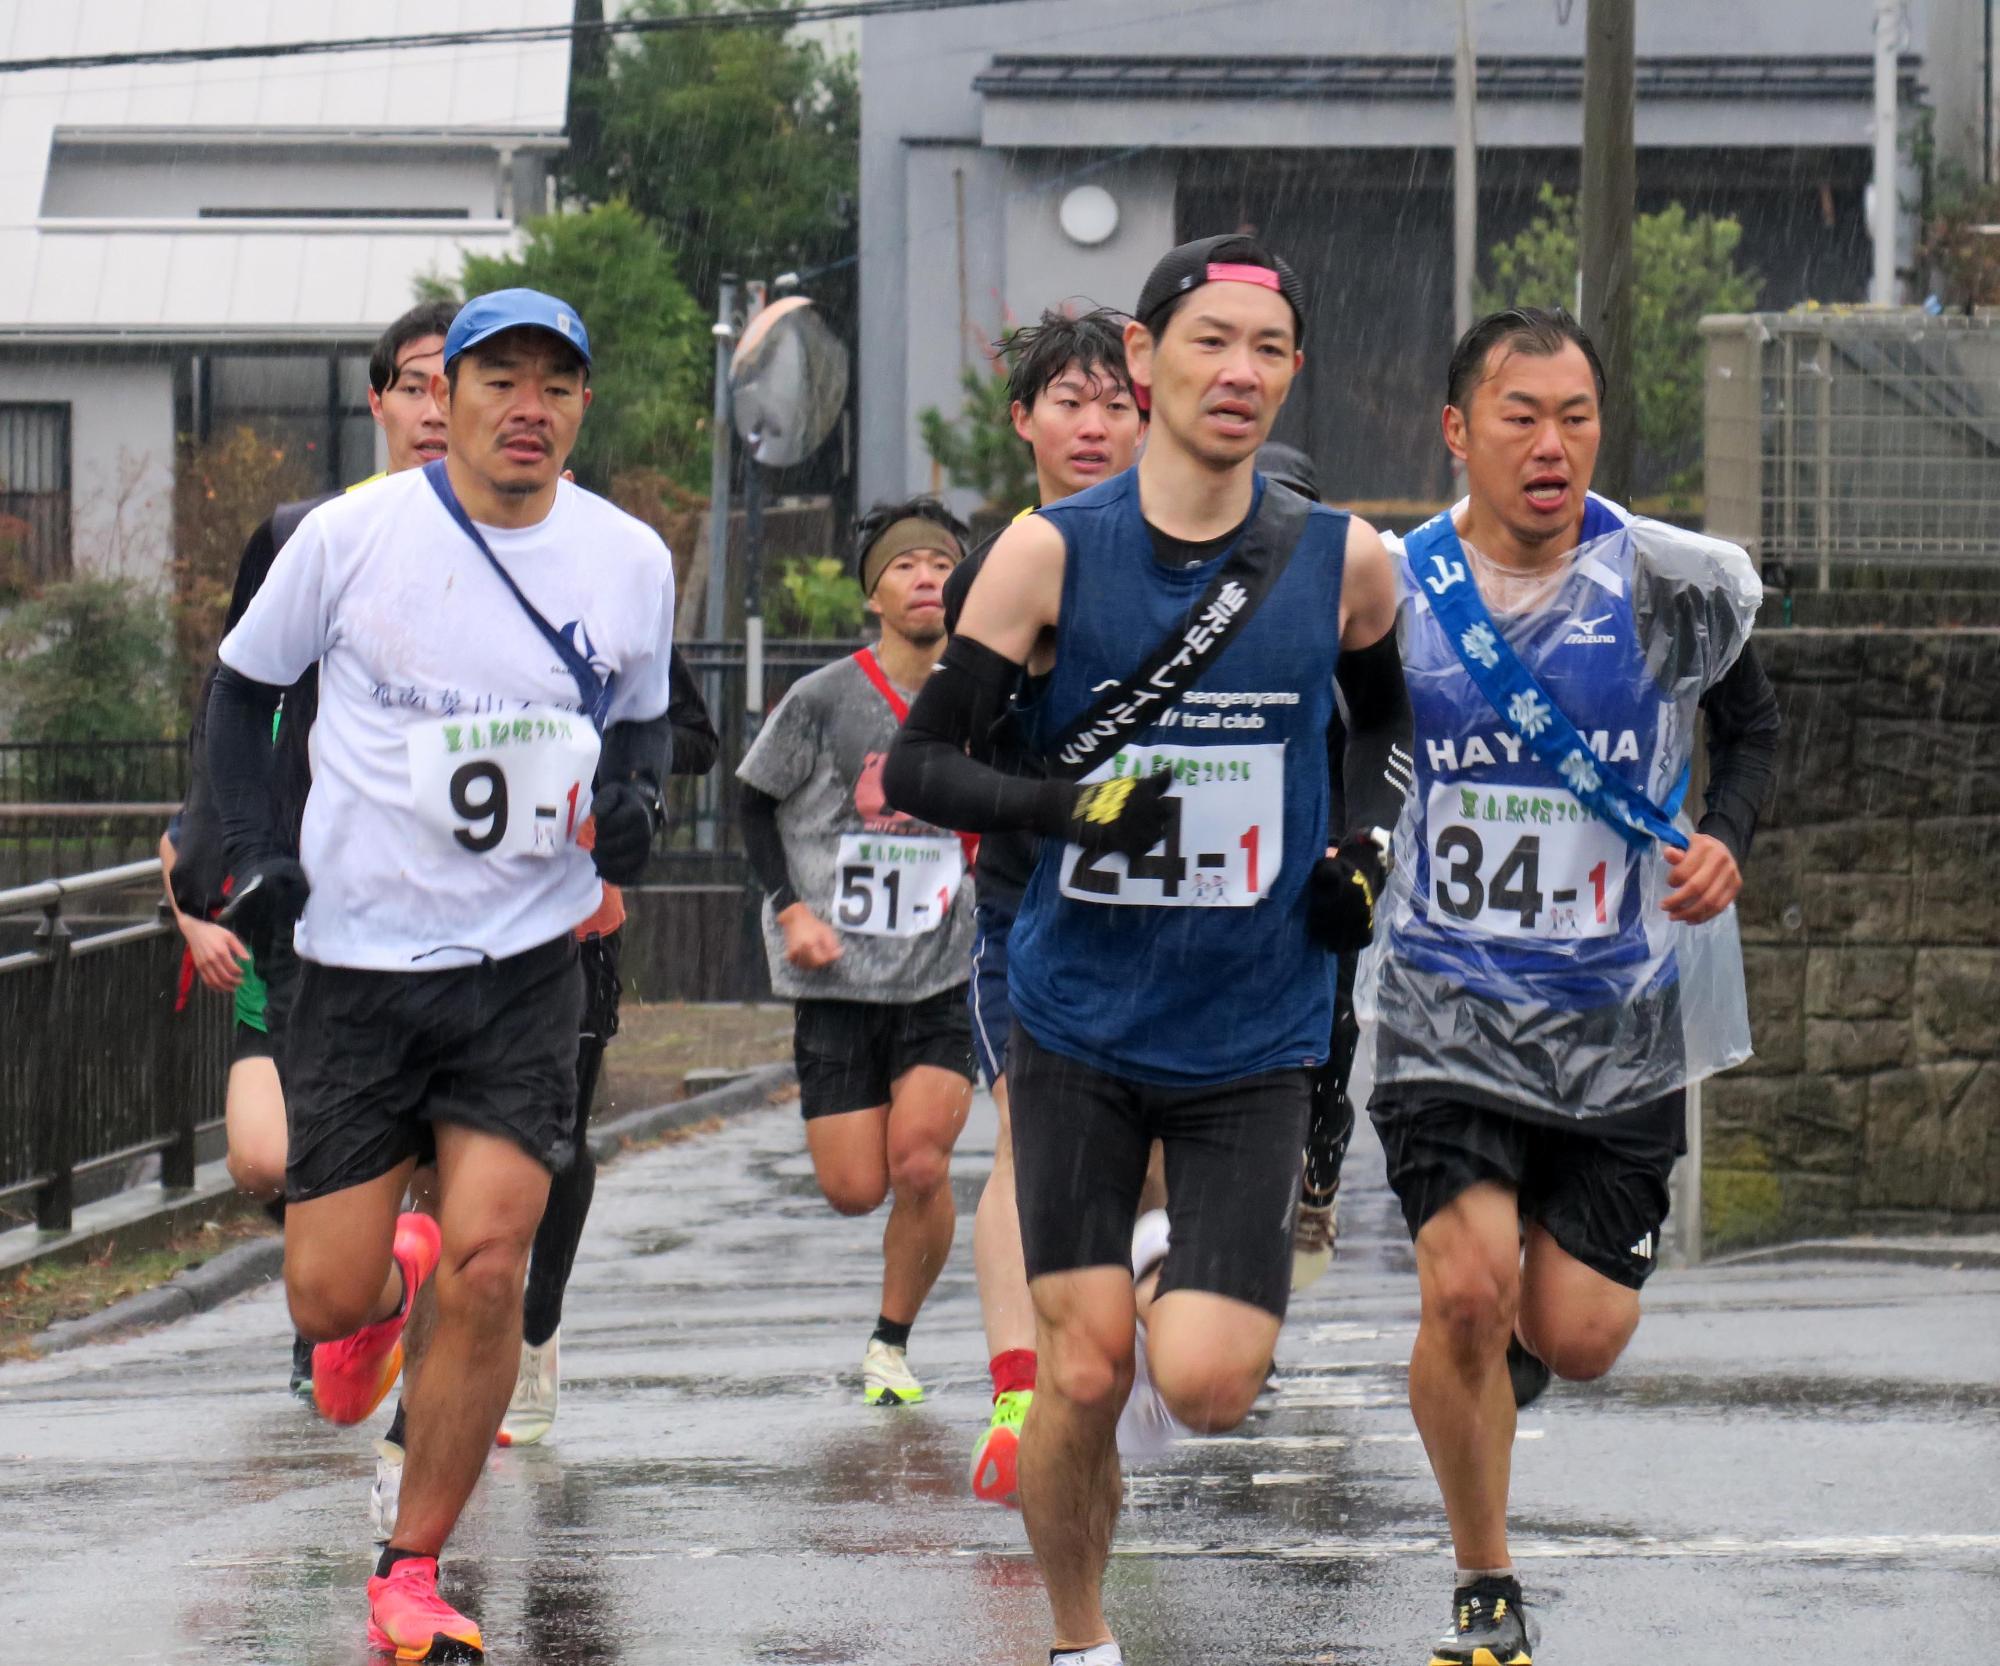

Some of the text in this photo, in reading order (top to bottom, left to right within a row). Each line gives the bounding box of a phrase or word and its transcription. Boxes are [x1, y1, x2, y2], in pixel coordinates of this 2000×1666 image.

[1182, 690, 1300, 708] sengenyama
[1182, 712, 1266, 728] trail club
[1425, 730, 1640, 771] HAYMA
[449, 760, 580, 852] 9-1
[839, 865, 949, 930] 51-1
[1435, 825, 1607, 928] 34-1
